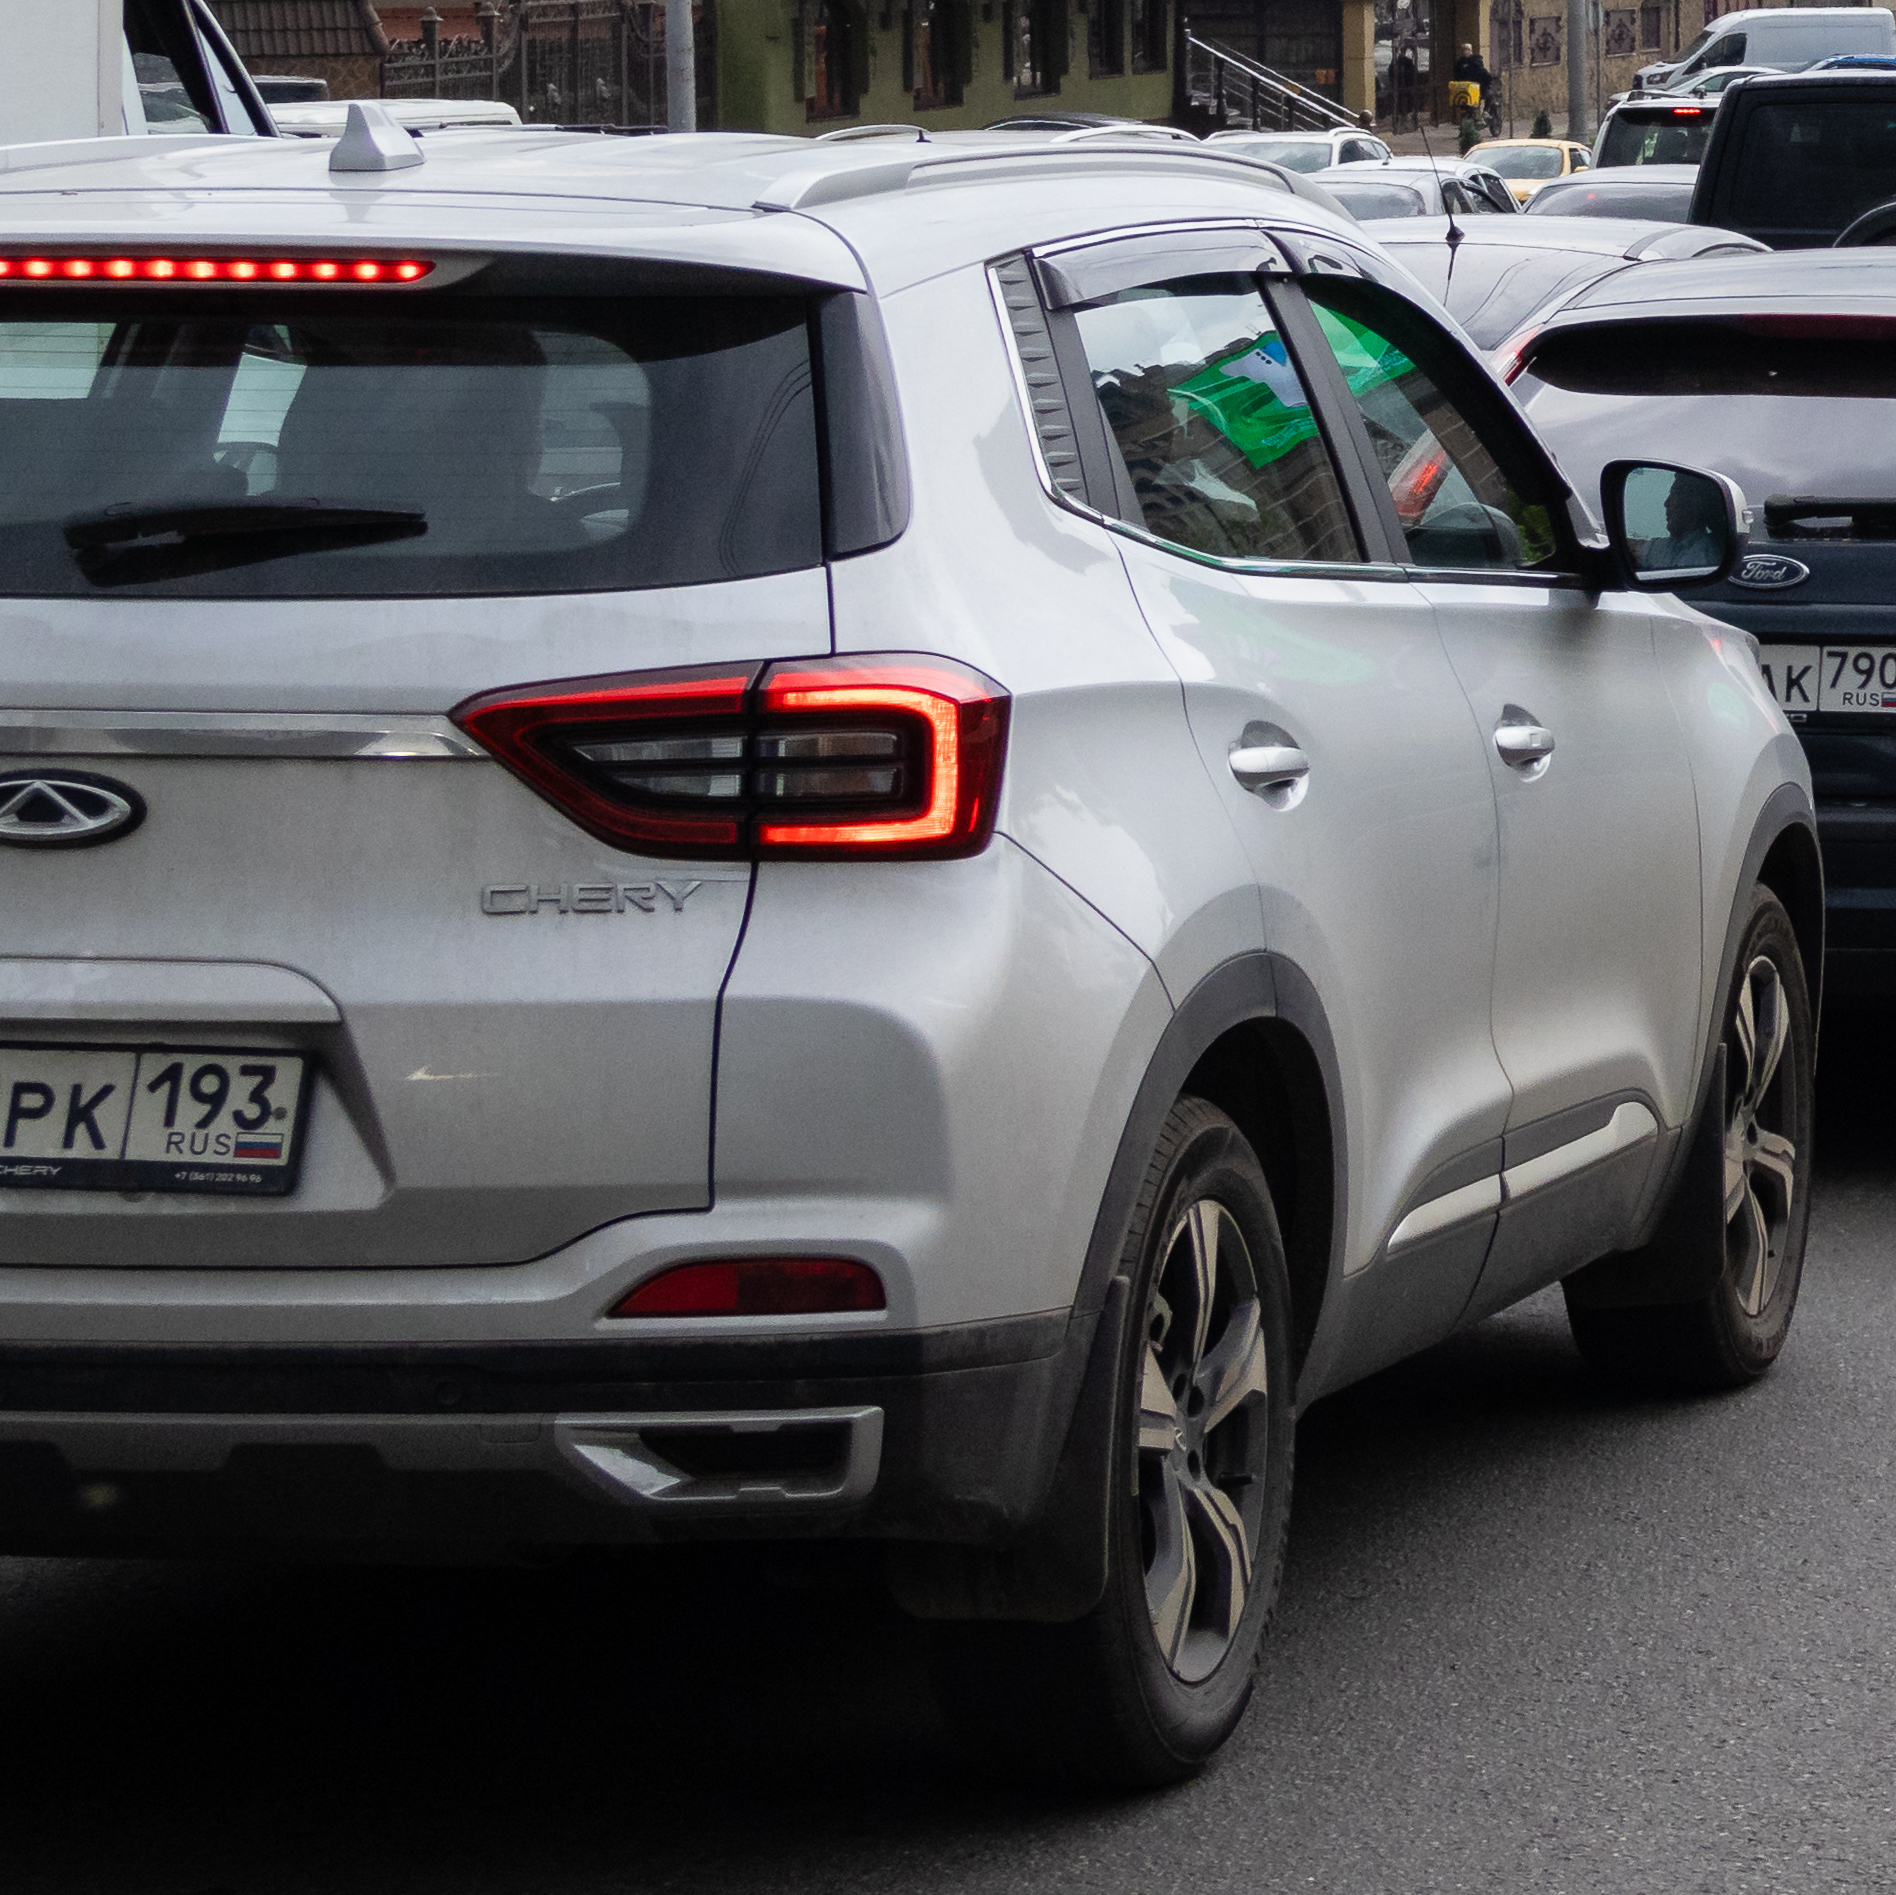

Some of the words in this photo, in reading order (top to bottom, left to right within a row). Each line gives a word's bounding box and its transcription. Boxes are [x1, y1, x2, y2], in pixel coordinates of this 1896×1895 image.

[1741, 561, 1787, 581] Ford
[1842, 692, 1880, 707] RUS
[483, 880, 702, 915] CHERY
[147, 1062, 276, 1131] 193
[166, 1132, 231, 1155] RUS
